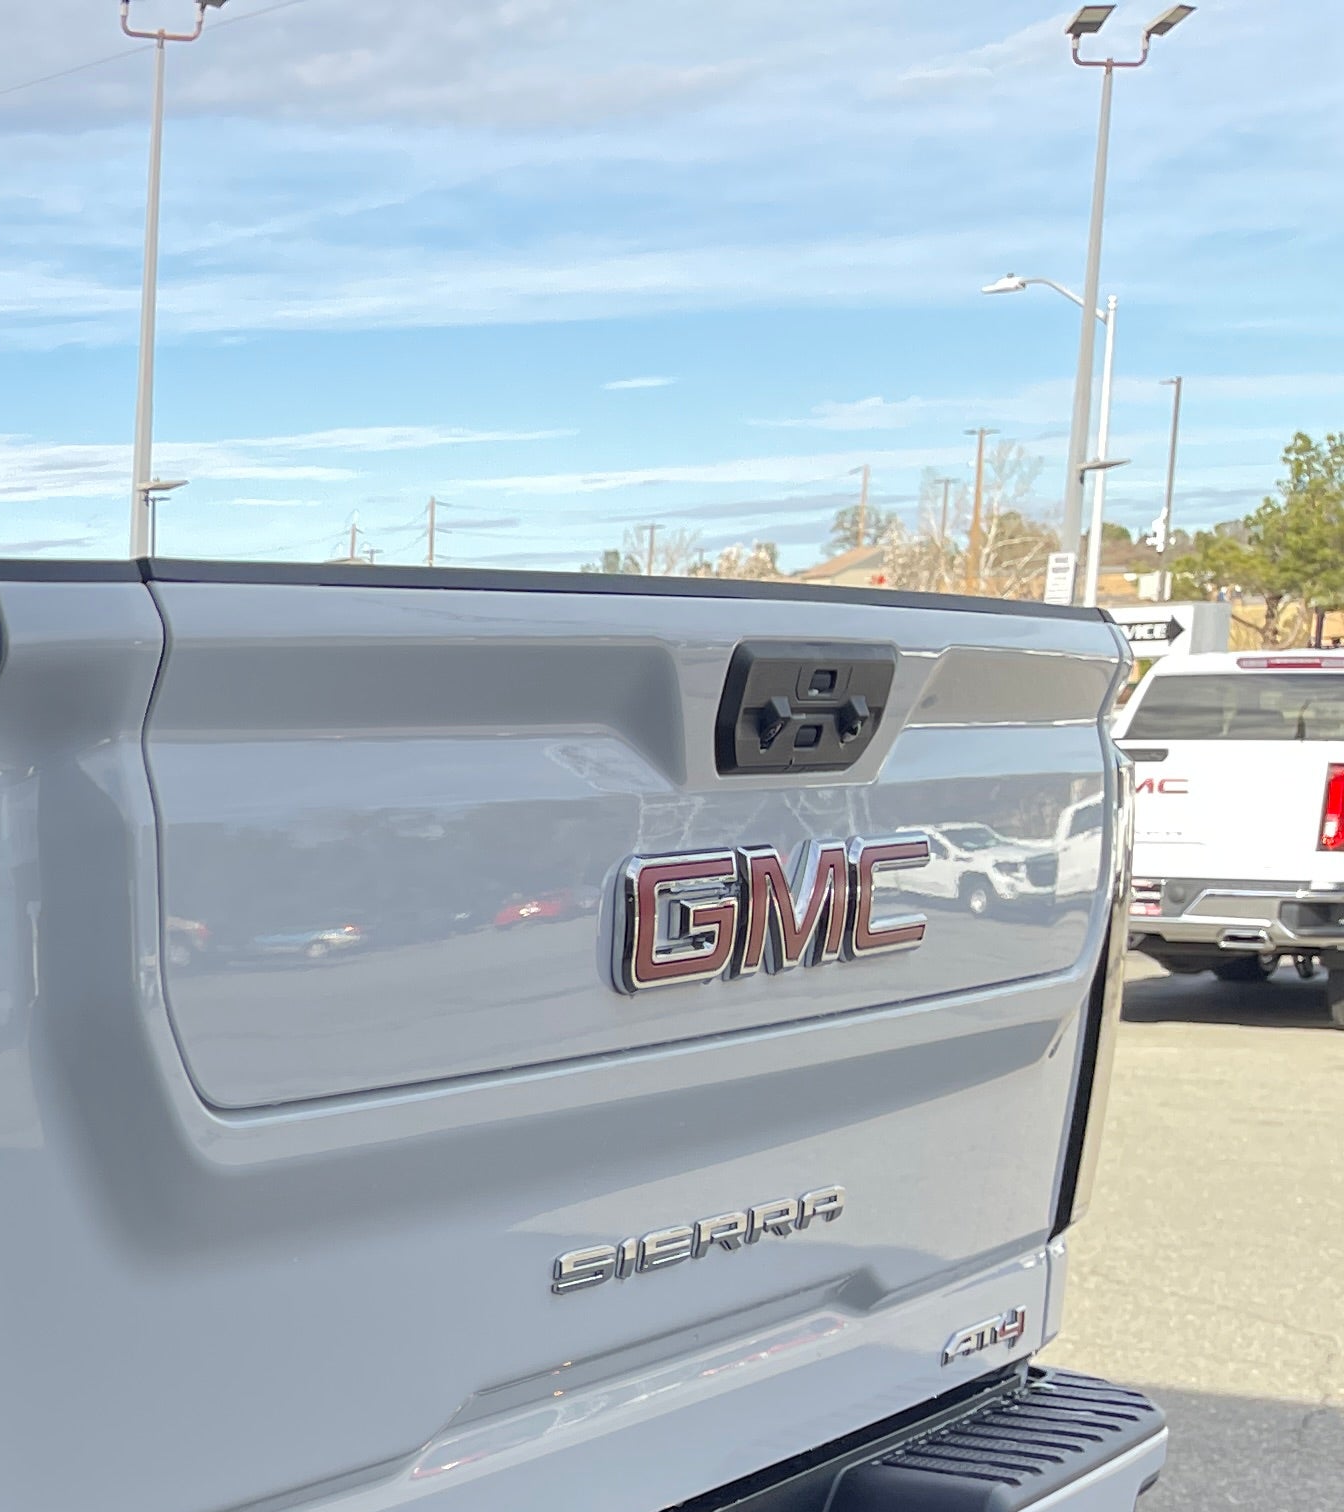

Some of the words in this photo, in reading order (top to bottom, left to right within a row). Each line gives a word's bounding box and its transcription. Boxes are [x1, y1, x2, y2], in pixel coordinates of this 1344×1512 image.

[615, 830, 930, 994] GMC
[551, 1184, 847, 1295] SIERRA
[941, 1304, 1027, 1368] AT4
